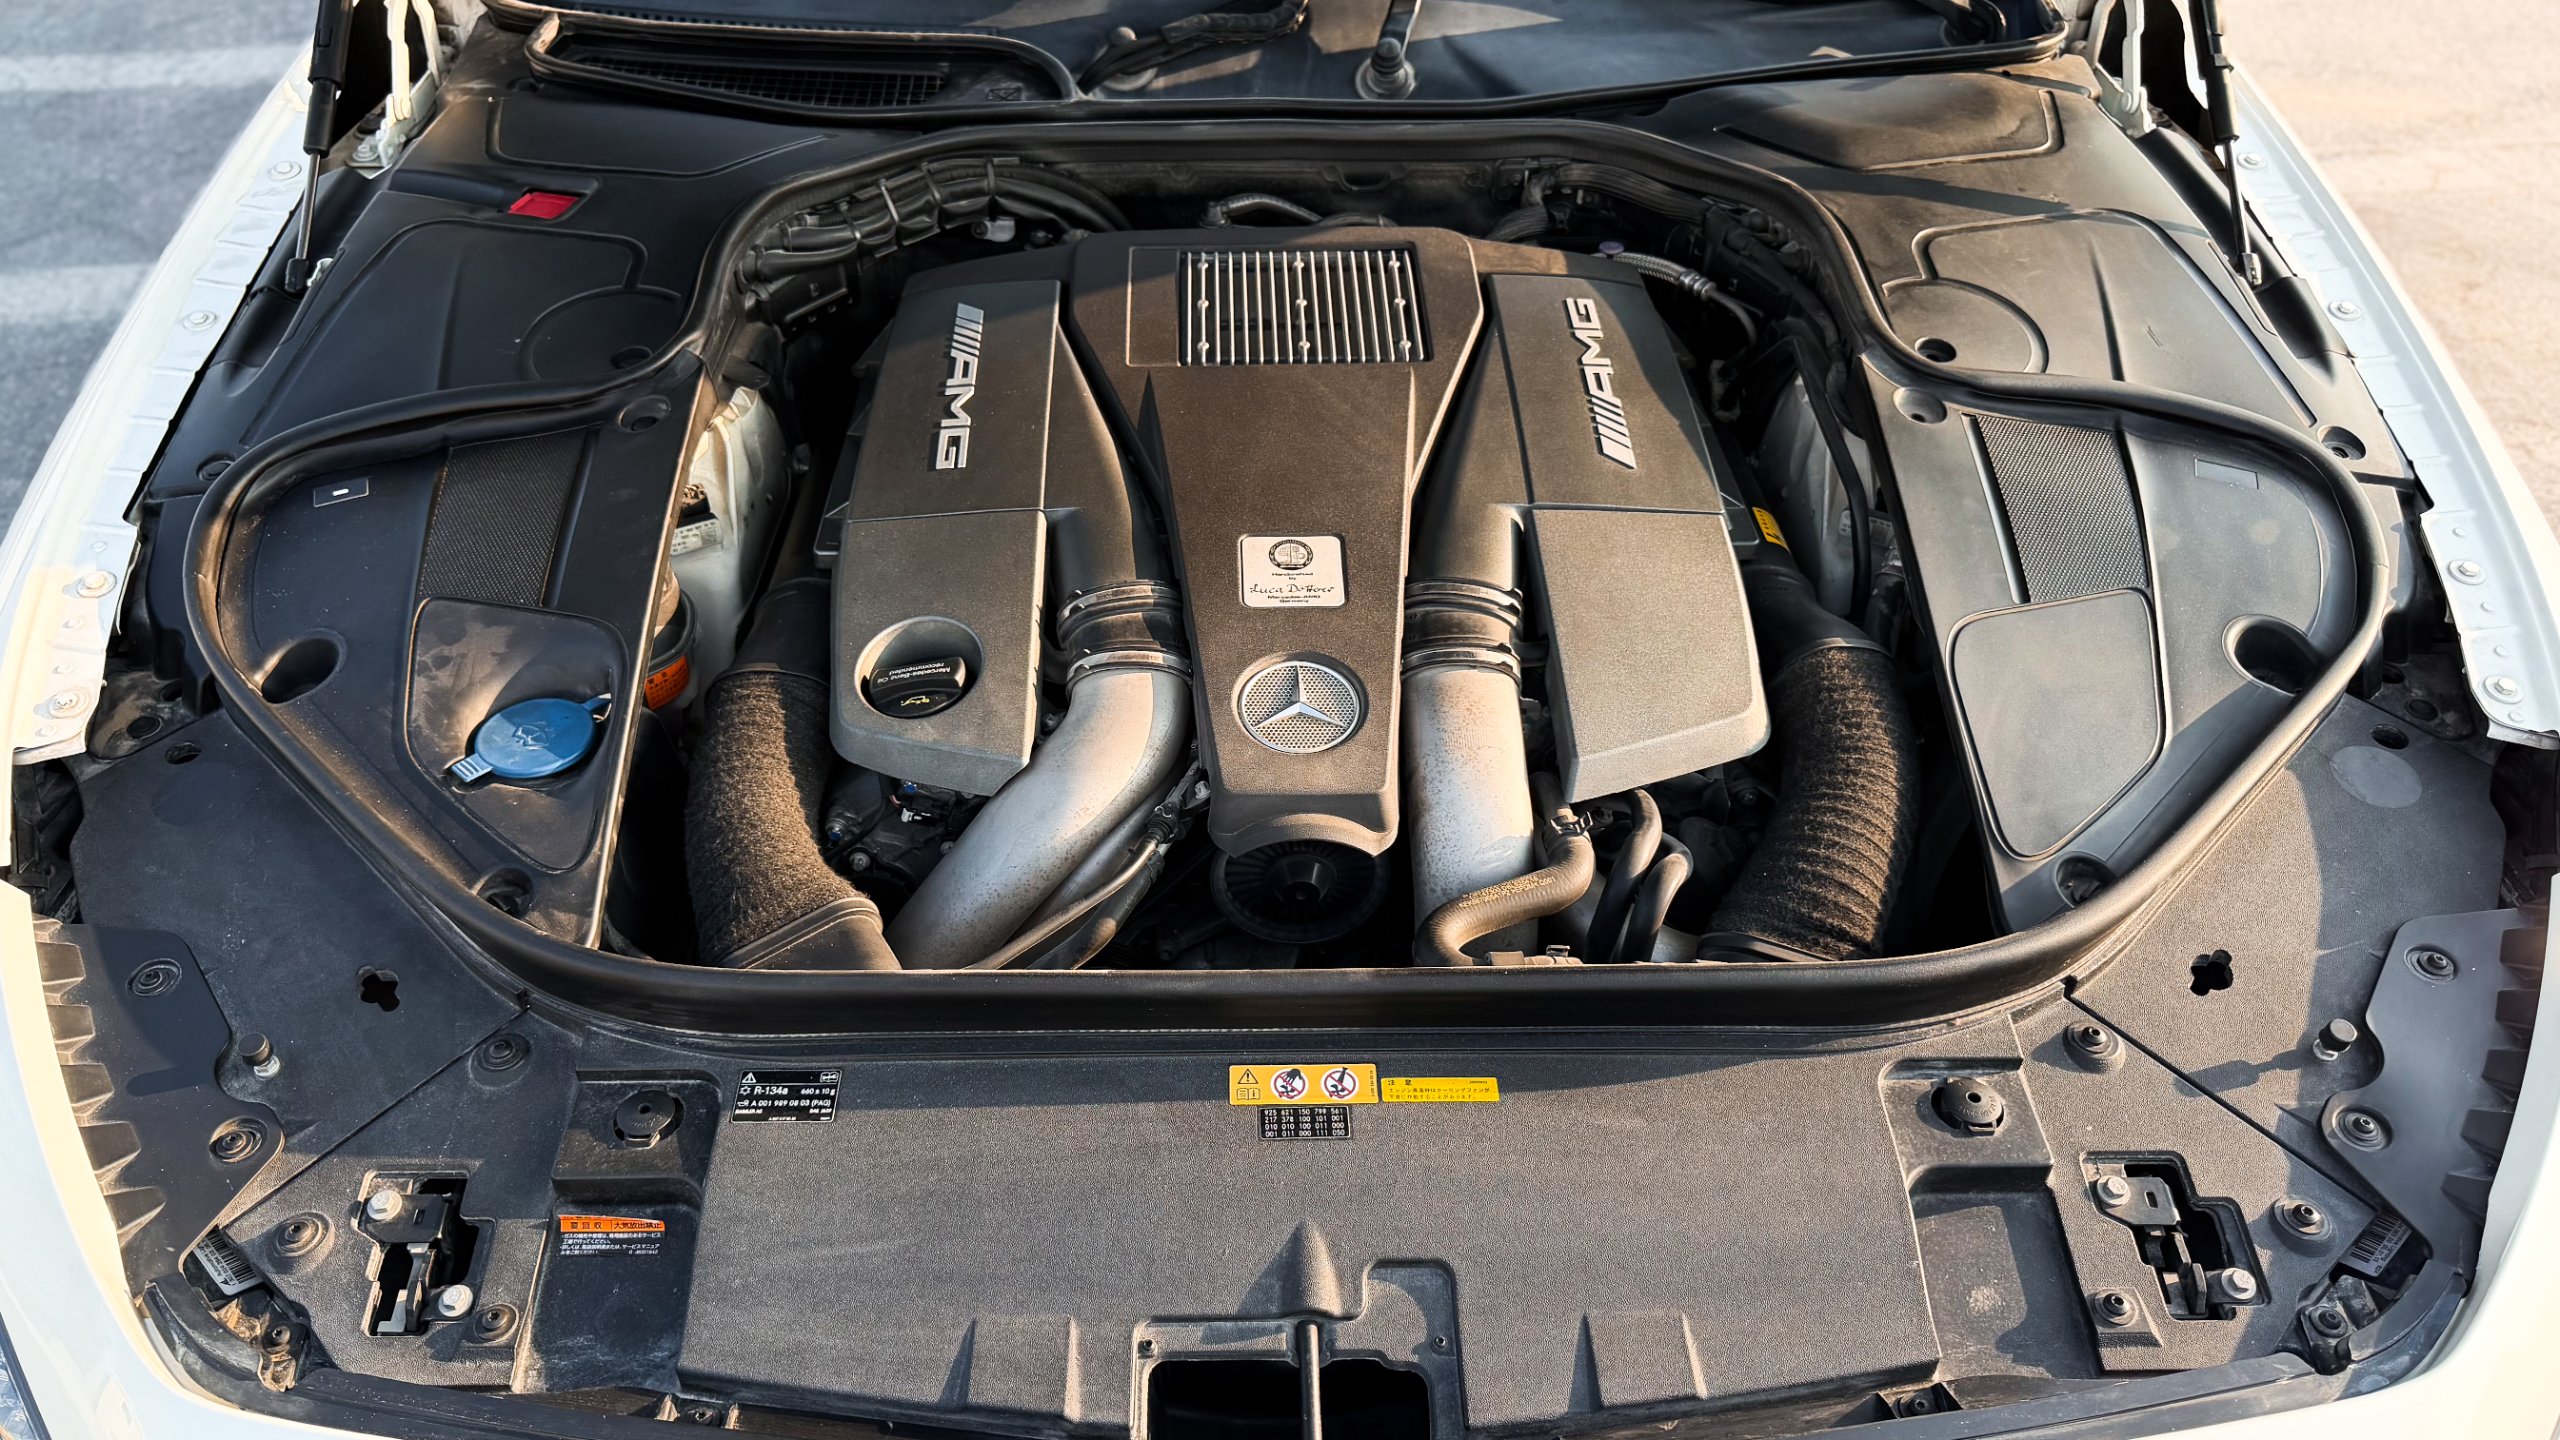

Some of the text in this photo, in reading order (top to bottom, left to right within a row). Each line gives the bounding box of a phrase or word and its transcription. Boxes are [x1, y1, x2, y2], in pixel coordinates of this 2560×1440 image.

[1566, 297, 1622, 408] AMG
[936, 349, 979, 470] AMG
[889, 662, 944, 676] recommended
[890, 667, 951, 680] Mercedes-Benz
[754, 1086, 788, 1095] R-134a
